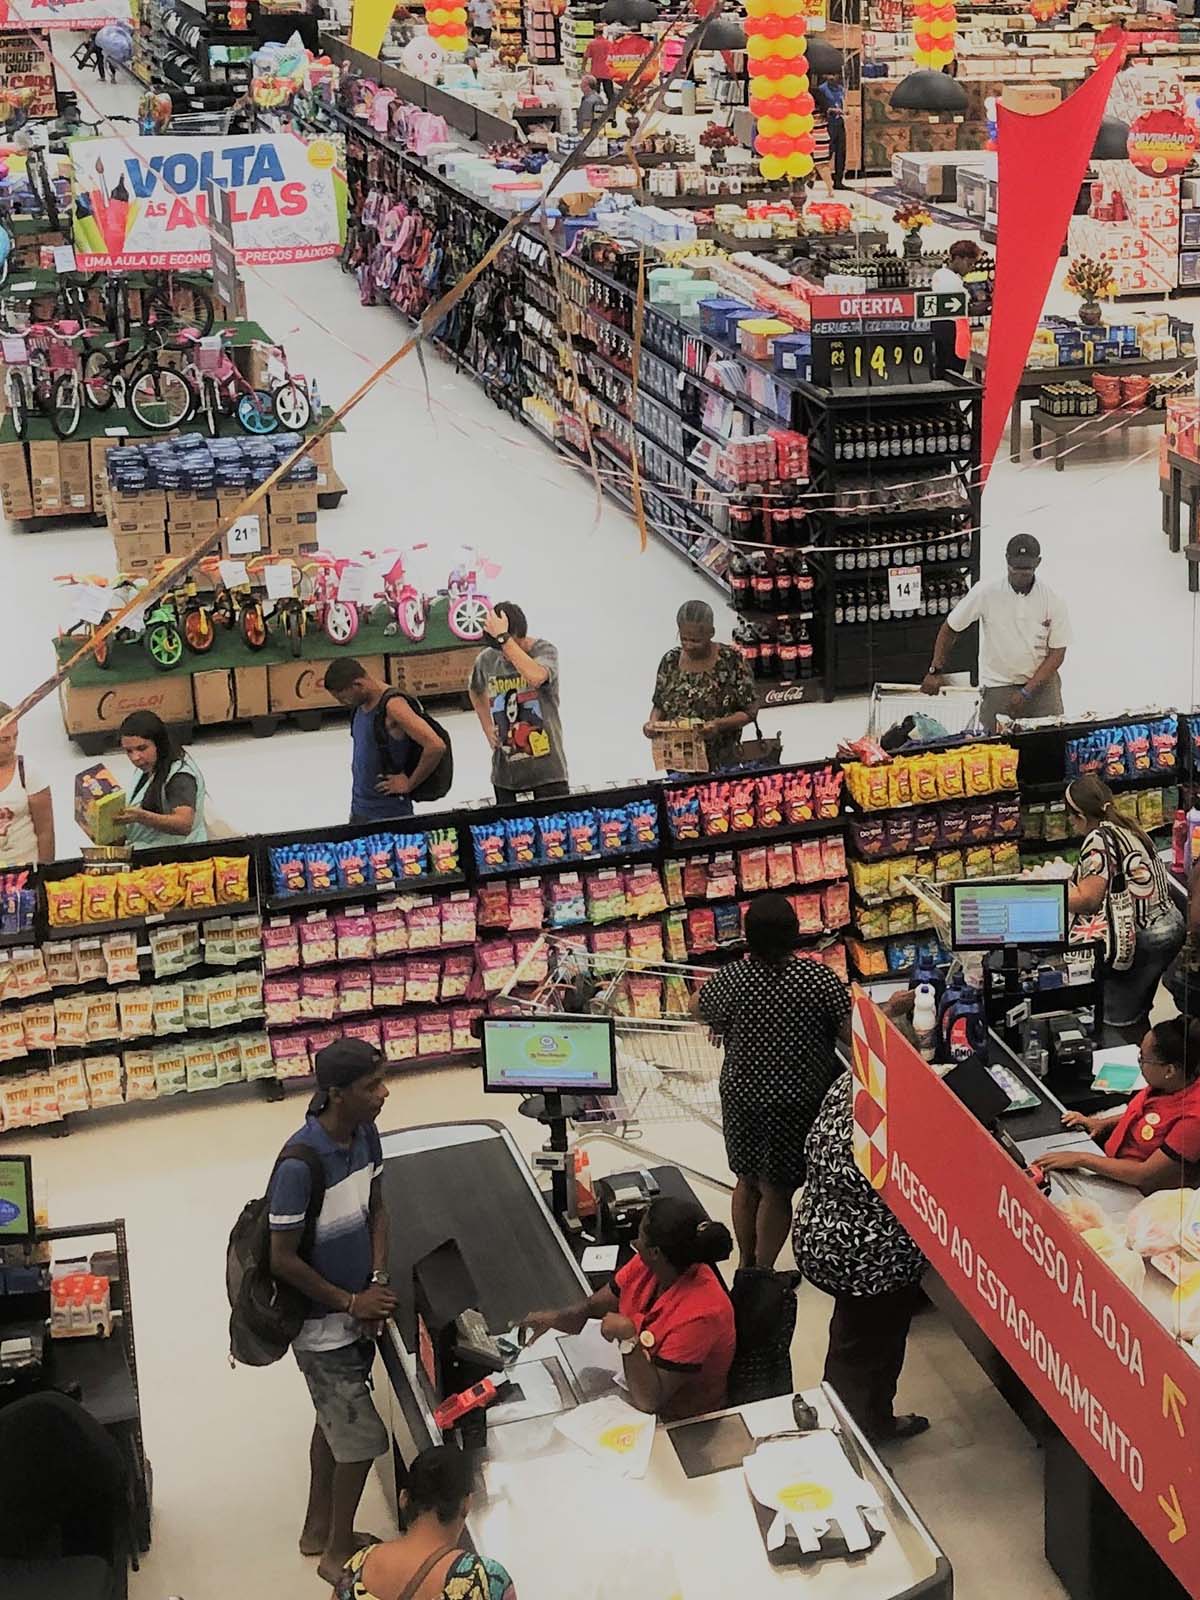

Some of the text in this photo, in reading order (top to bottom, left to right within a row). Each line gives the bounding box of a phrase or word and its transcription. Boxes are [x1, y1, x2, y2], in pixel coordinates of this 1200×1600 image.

[1129, 132, 1195, 143] ANIVERSÁRIO
[124, 143, 285, 199] VOLTA
[145, 182, 308, 232] ÀS AULAS
[84, 256, 113, 267] UMA
[114, 254, 150, 266] AULA
[150, 254, 167, 265] DE
[169, 253, 210, 265] ECONO
[247, 249, 293, 263] PREÇOS
[294, 246, 335, 260] BAIXOS
[840, 297, 904, 316] OFERTA
[813, 320, 863, 335] CERVEJA
[831, 350, 845, 365] R$
[234, 527, 249, 542] 21
[896, 582, 911, 598] 14
[971, 813, 992, 823] Doritos
[999, 806, 1019, 815] Doritos
[998, 1184, 1146, 1387] ACESSO À LOJA
[890, 1150, 1144, 1494] ACESSO AO ESTACIONAMENTO
